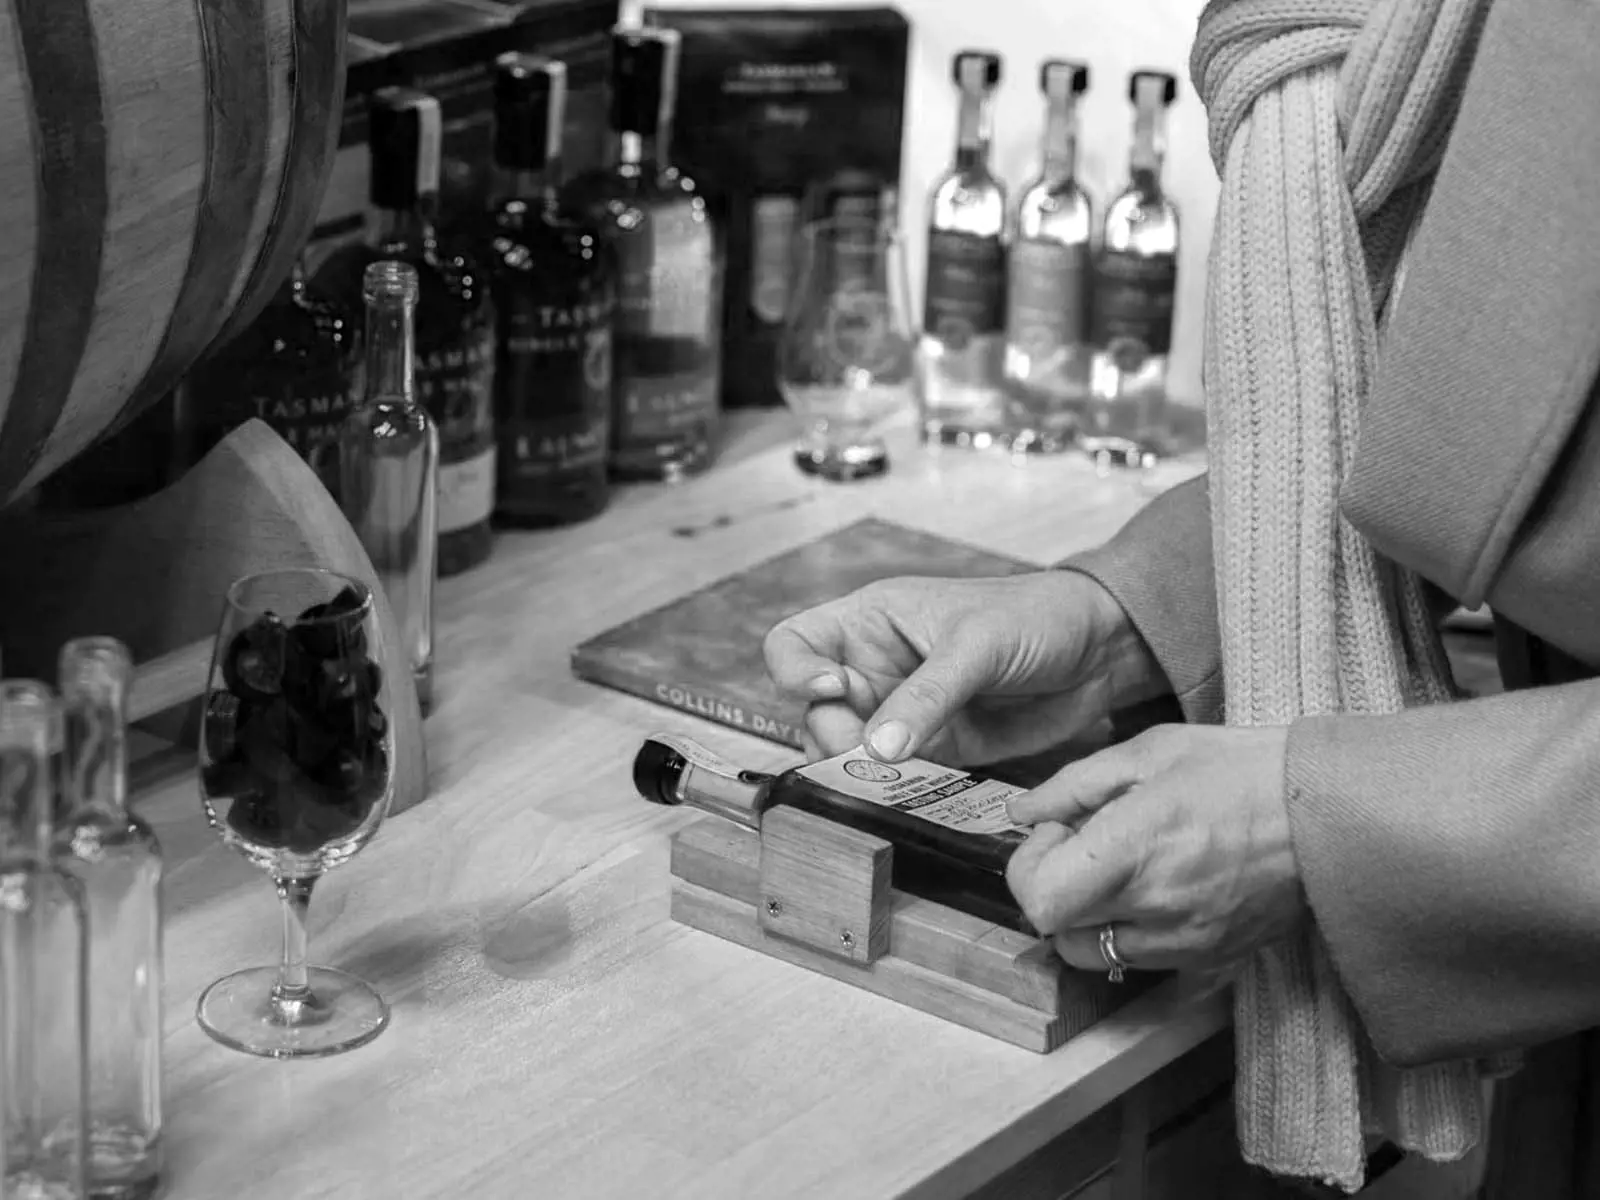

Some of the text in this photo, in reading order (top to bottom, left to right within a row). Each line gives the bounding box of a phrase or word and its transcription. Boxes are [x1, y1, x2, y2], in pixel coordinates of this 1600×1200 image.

[252, 393, 345, 418] TASMA
[656, 684, 744, 724] COLLINS
[753, 715, 791, 737] DAY
